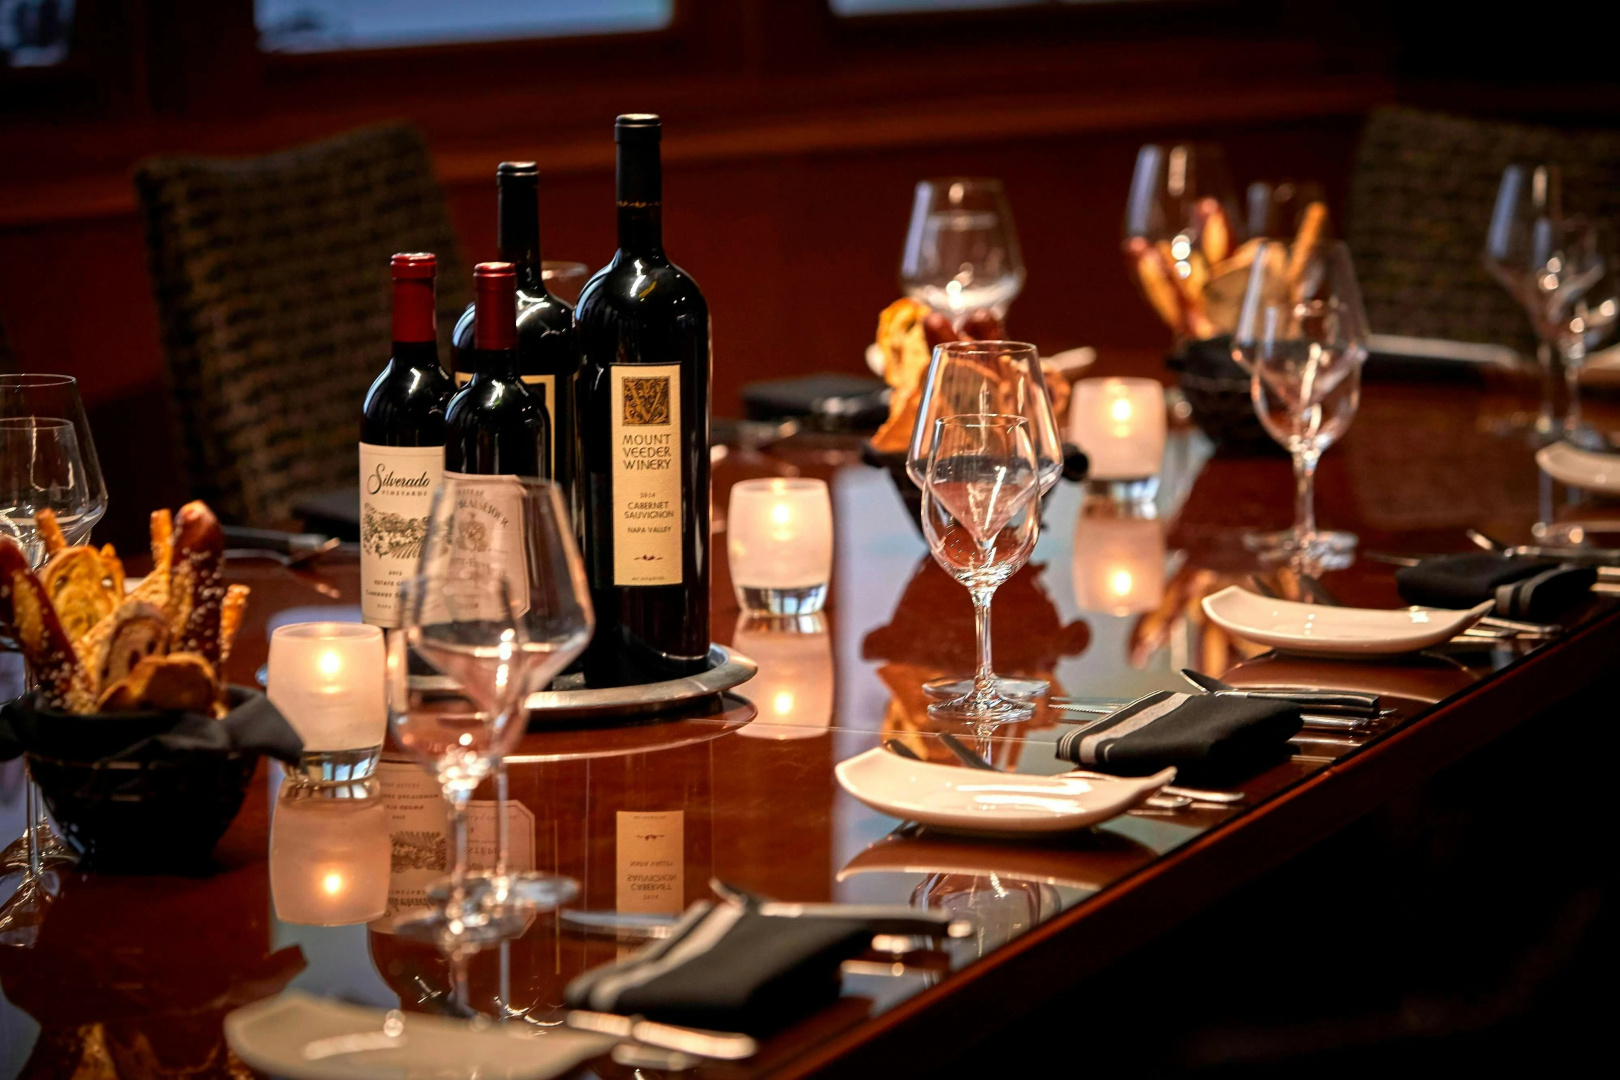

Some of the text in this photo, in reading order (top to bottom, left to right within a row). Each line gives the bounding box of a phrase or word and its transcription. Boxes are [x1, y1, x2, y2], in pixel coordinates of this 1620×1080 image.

[622, 434, 671, 445] MOUNT
[622, 446, 671, 458] VEEDER
[623, 459, 671, 470] WINERY
[367, 463, 430, 494] Silverado
[627, 501, 669, 510] CABERNET
[624, 510, 675, 519] SAUVIGNON
[648, 525, 672, 533] VALLEY
